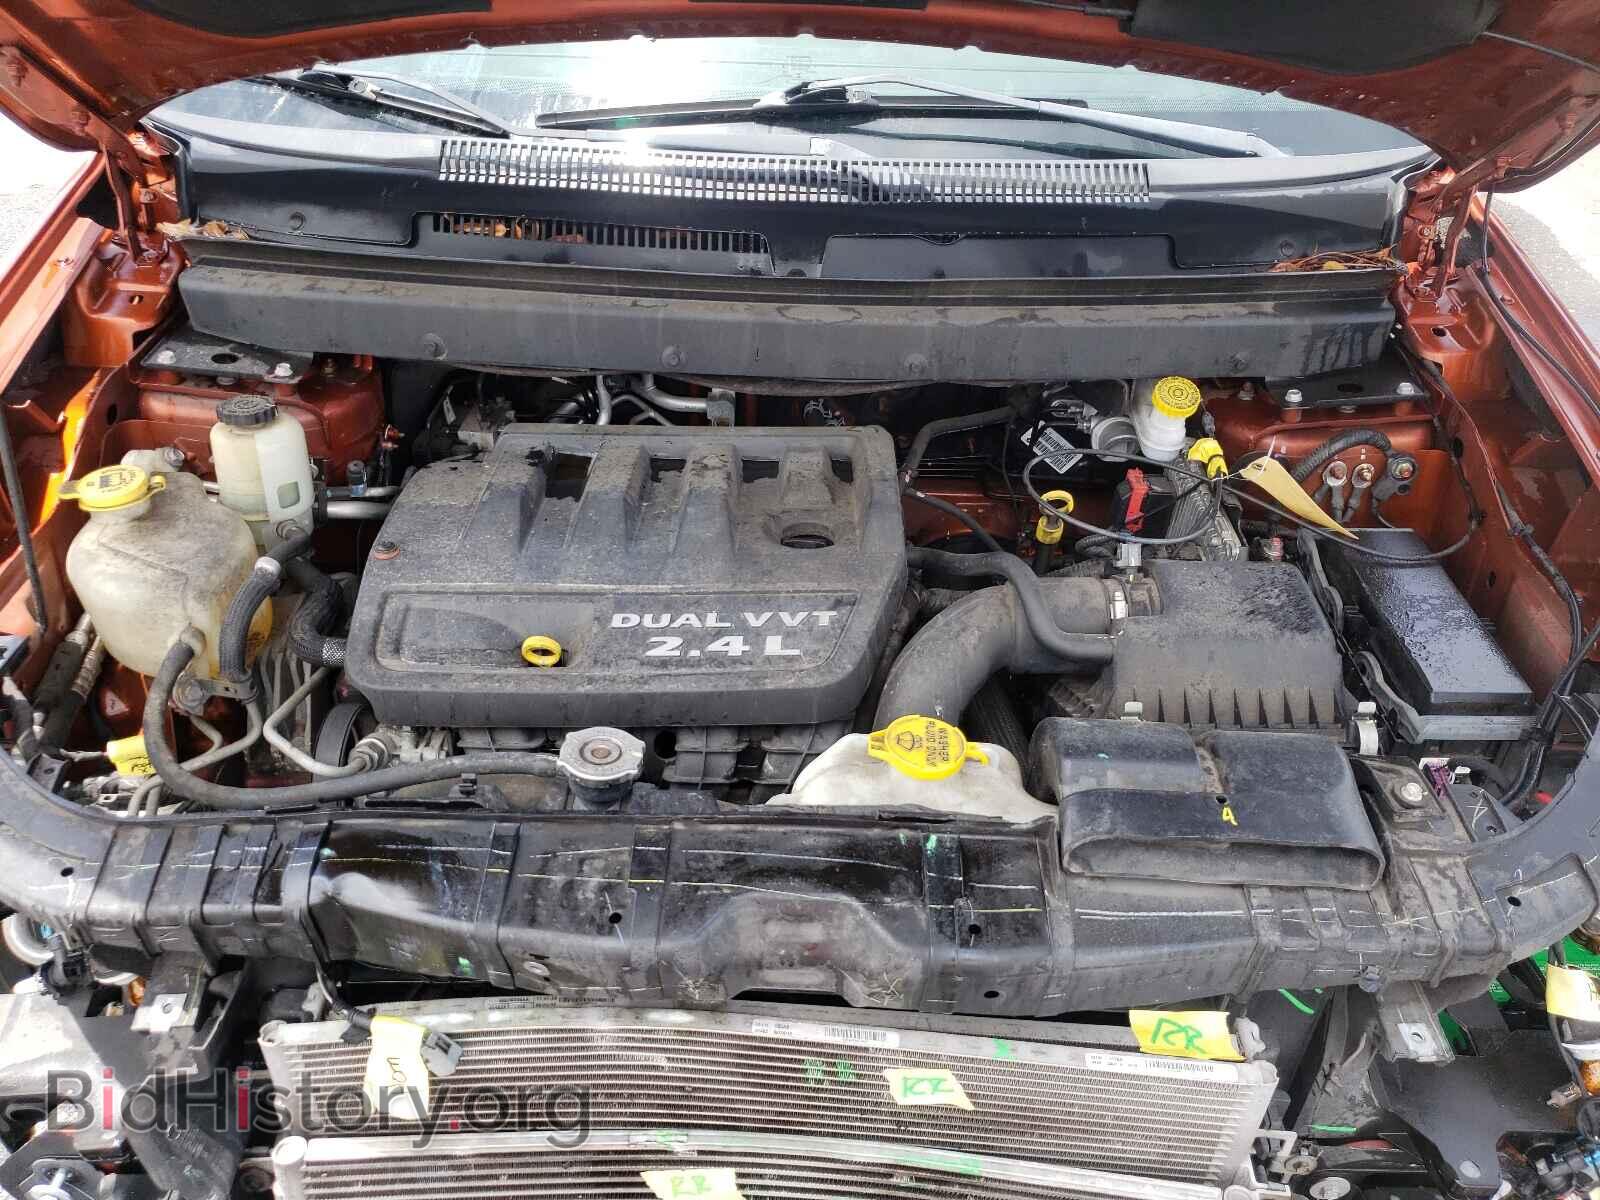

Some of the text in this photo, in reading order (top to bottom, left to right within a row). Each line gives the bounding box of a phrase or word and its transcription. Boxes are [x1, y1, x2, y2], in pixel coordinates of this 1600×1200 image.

[610, 611, 838, 628] DUAL VVT
[645, 635, 802, 657] 2.4 L
